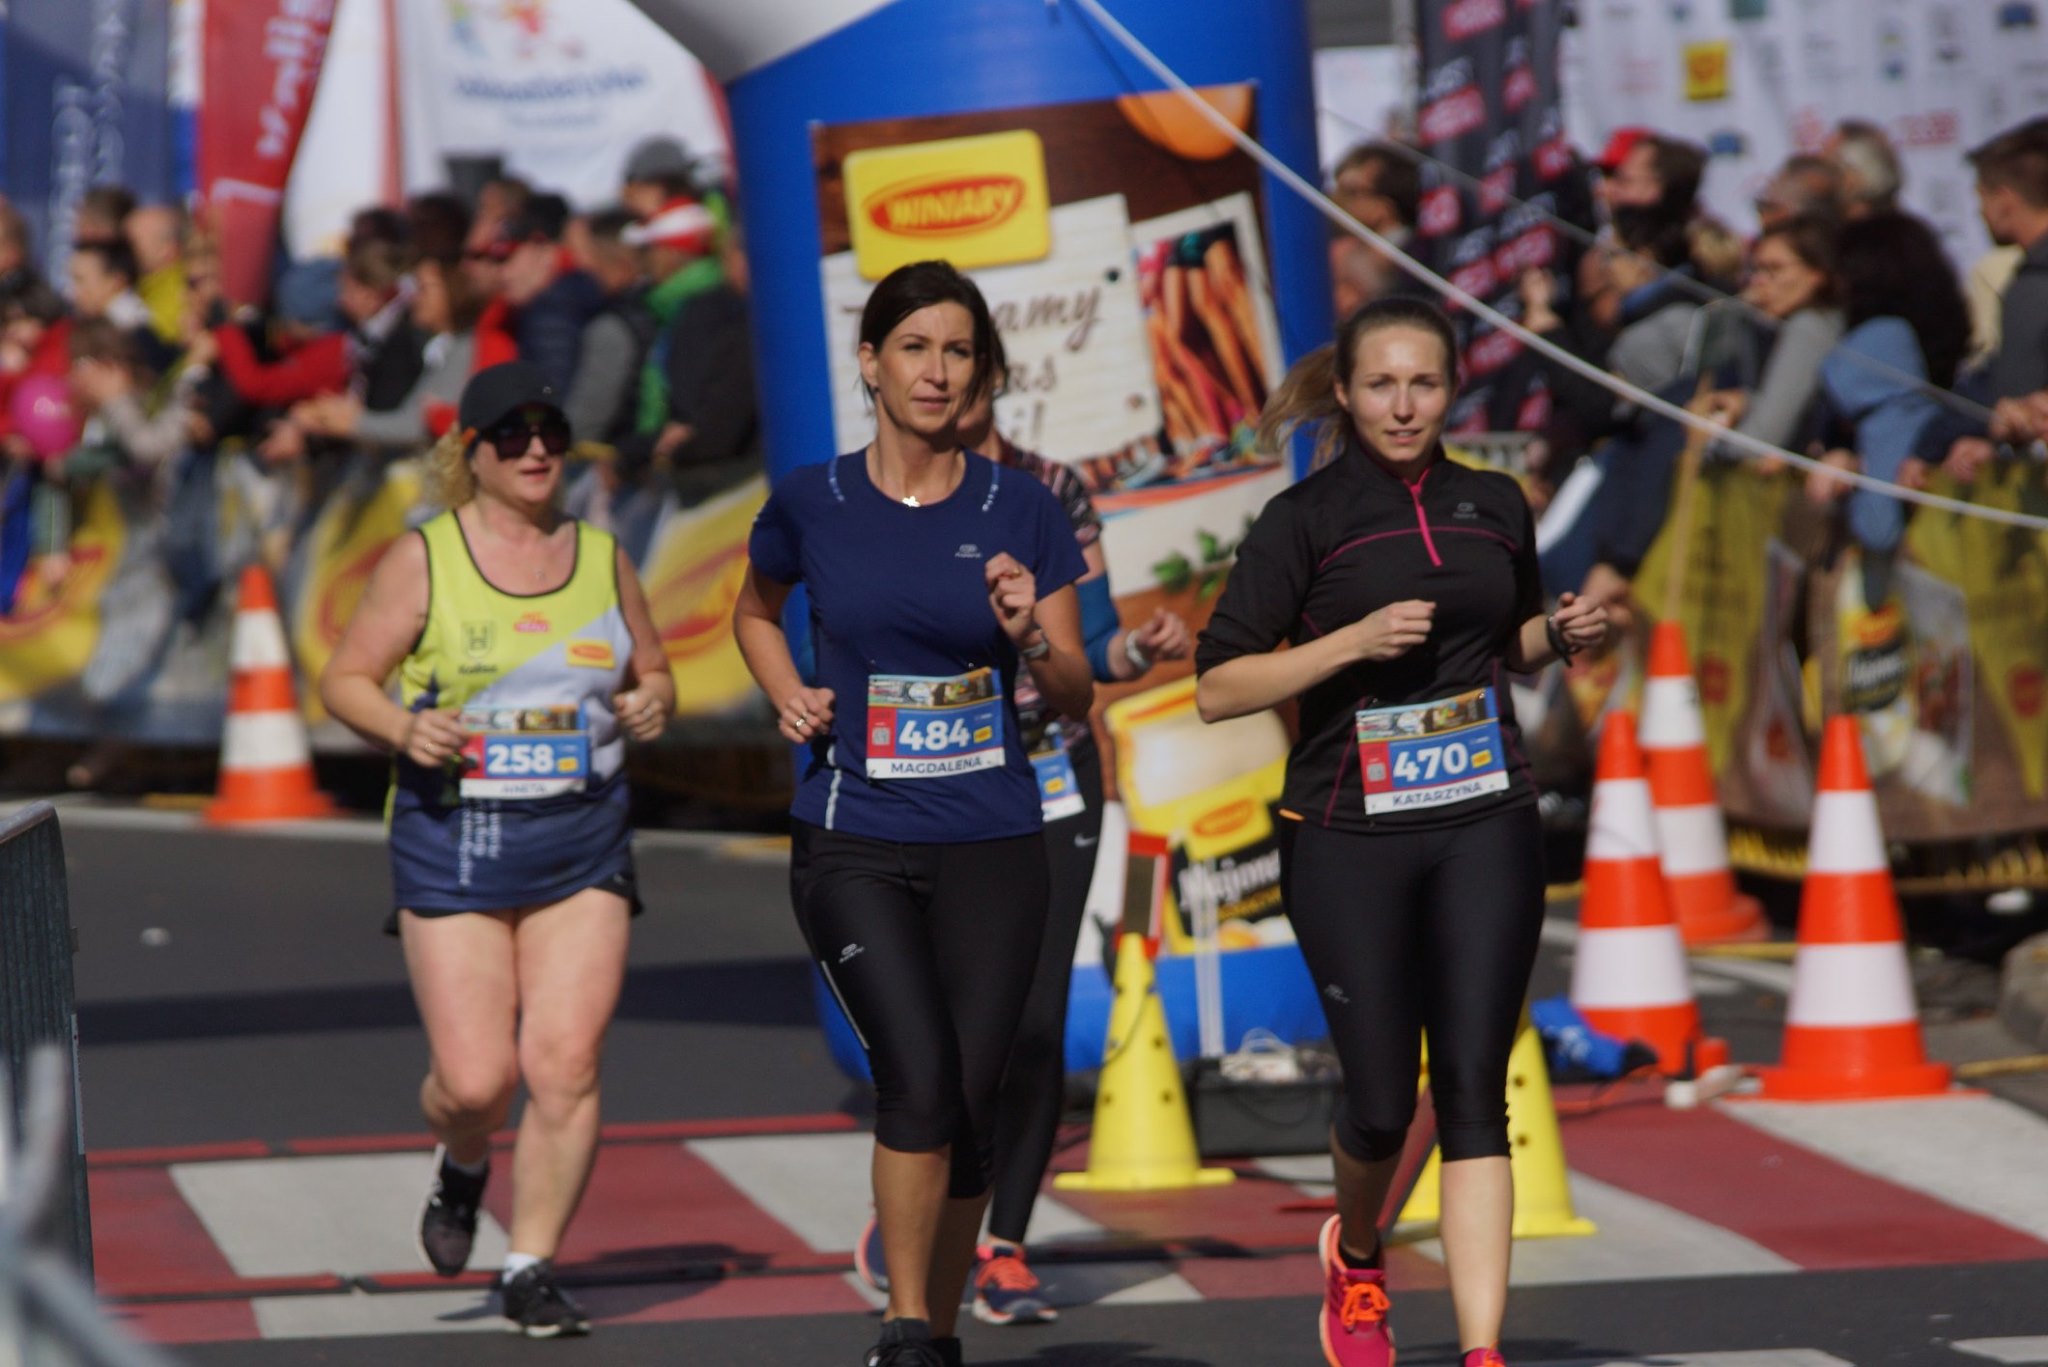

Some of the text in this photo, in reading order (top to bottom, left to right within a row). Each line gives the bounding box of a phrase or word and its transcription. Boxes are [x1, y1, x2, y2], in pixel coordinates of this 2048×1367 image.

[889, 184, 1021, 228] WINIARY
[898, 718, 970, 752] 484
[486, 743, 554, 774] 258
[890, 756, 983, 775] MAGDALENA
[1392, 742, 1469, 782] 470
[1392, 781, 1482, 806] KATARZYNA
